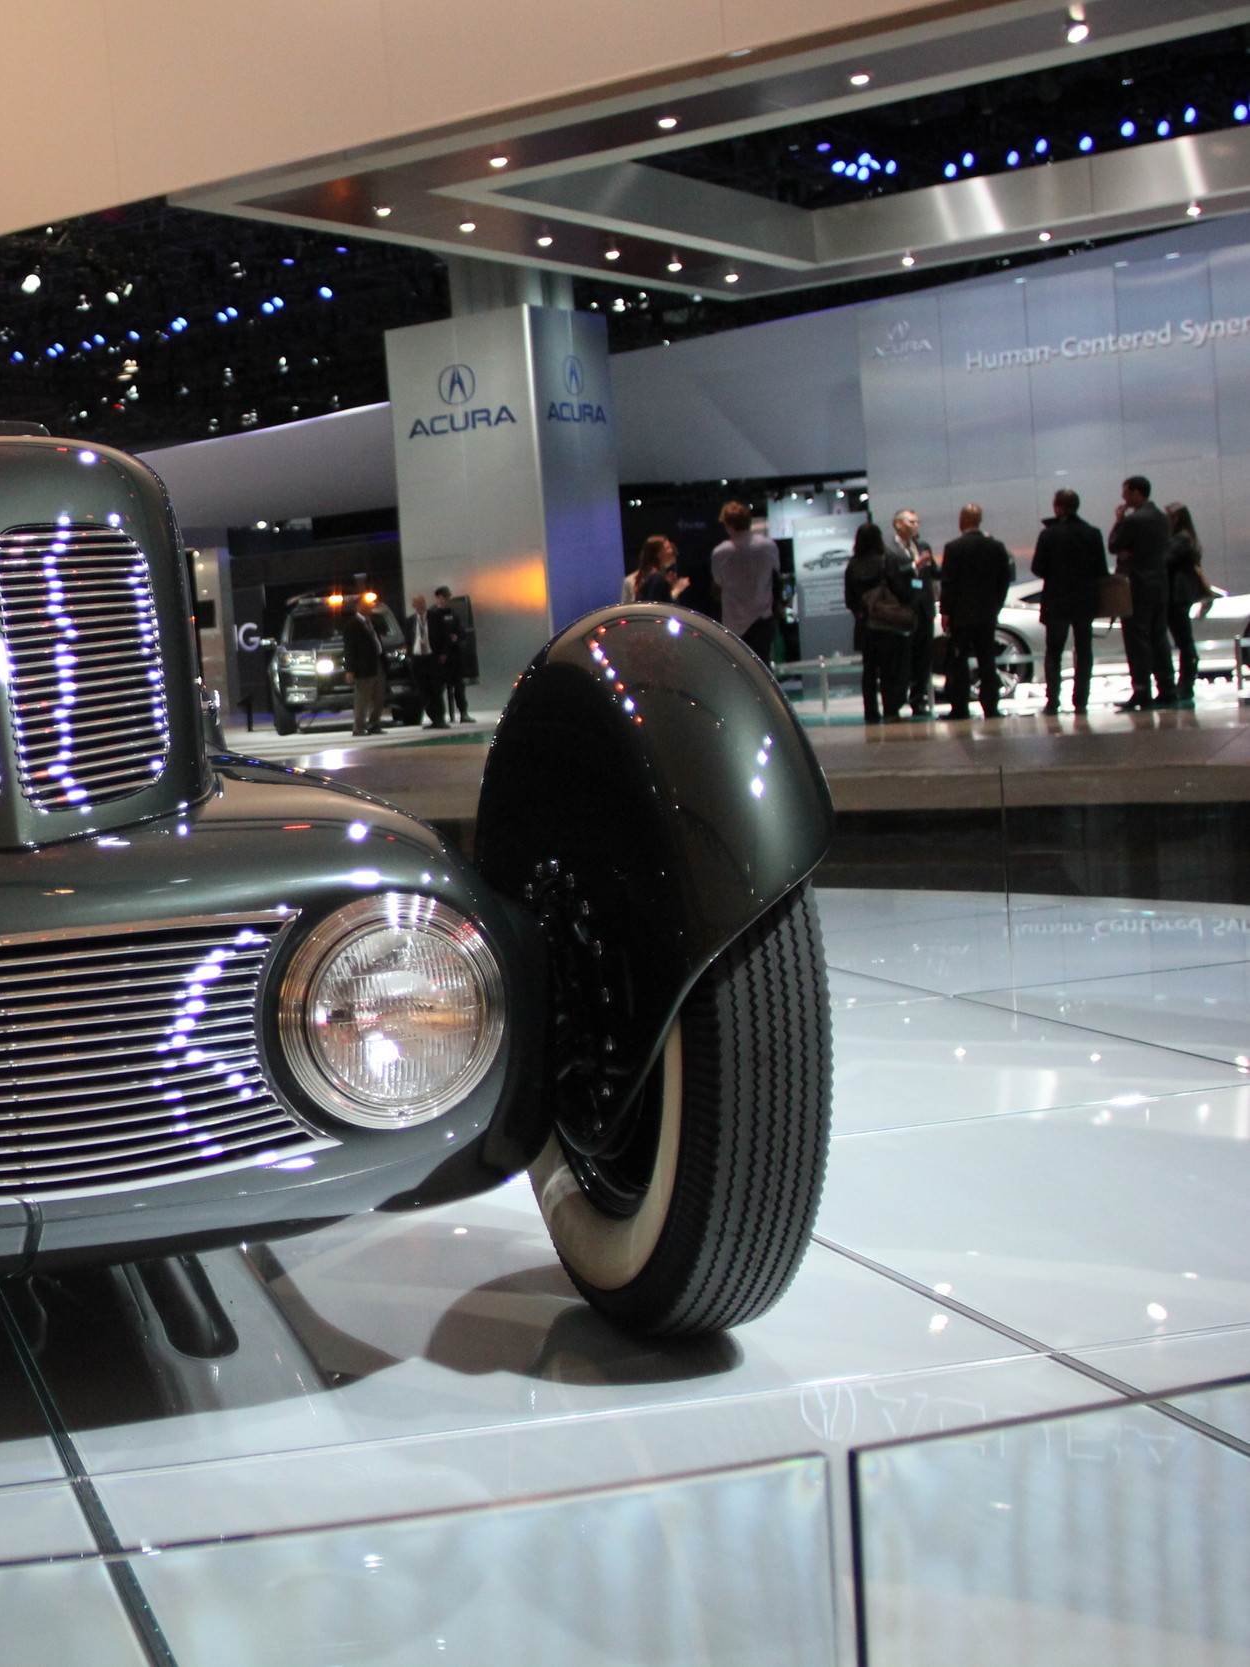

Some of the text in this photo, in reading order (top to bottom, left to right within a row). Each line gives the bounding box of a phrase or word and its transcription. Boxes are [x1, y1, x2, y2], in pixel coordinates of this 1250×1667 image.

[965, 319, 1172, 372] Human-Centered
[408, 405, 517, 439] ACURA
[547, 402, 606, 424] ACURA
